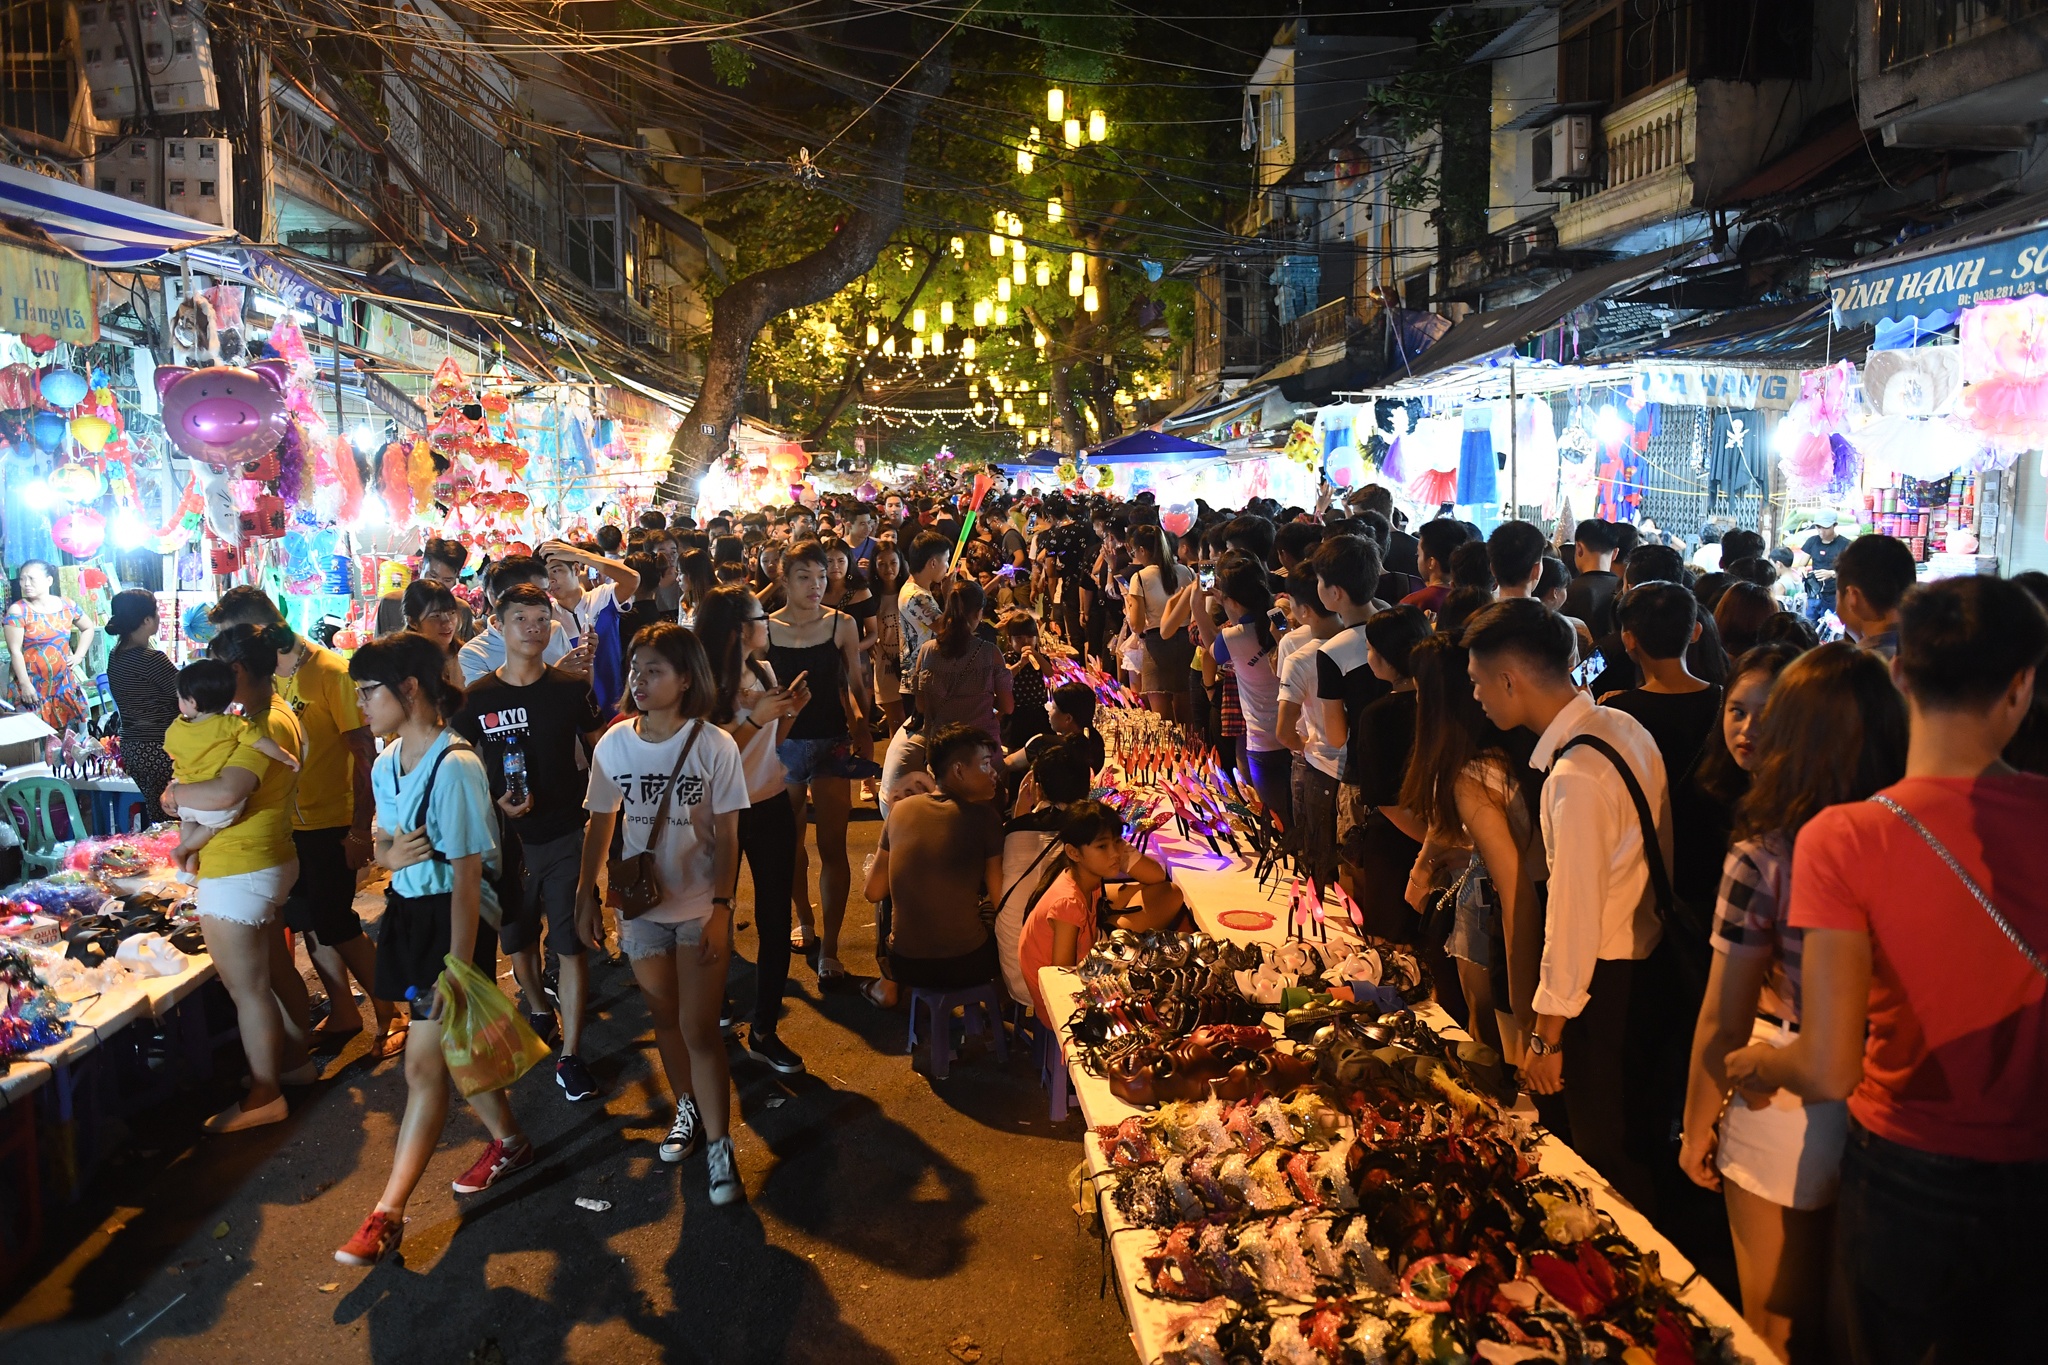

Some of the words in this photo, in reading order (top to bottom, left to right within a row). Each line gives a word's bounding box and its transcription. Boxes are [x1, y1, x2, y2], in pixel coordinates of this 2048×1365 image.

[1895, 257, 1986, 305] HẠNH
[703, 425, 713, 434] 19
[478, 707, 528, 730] TOKYO
